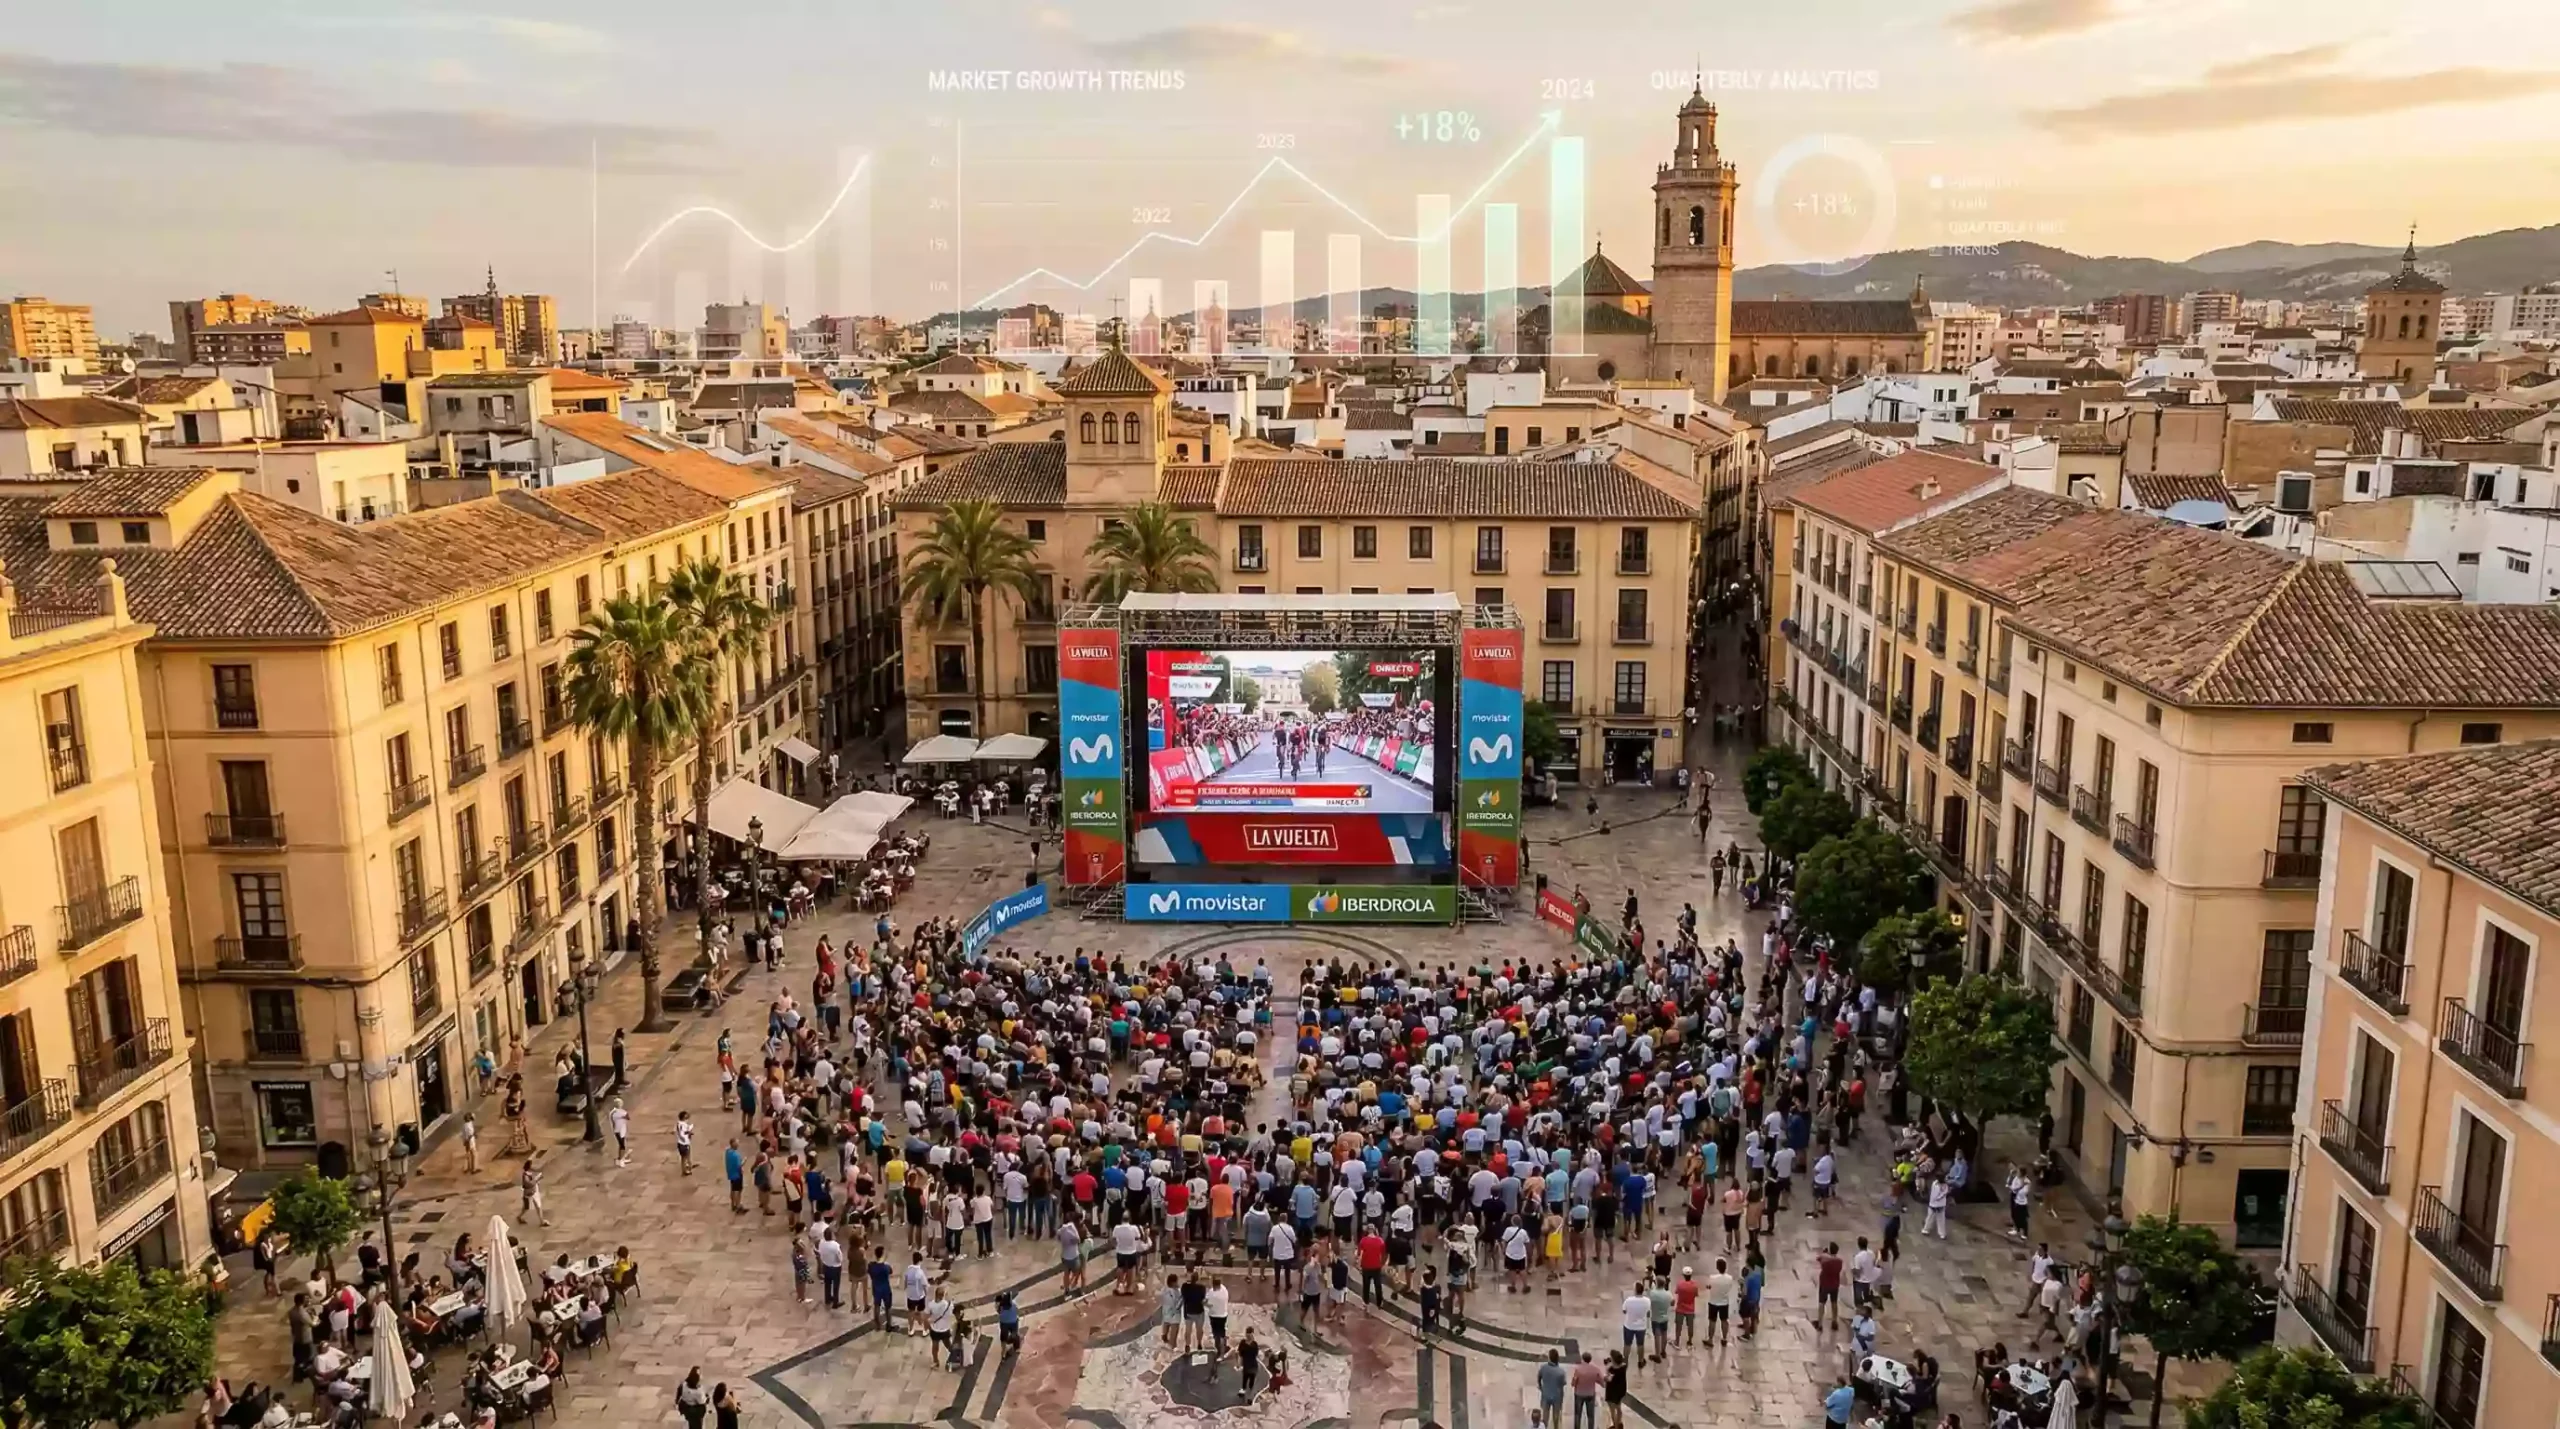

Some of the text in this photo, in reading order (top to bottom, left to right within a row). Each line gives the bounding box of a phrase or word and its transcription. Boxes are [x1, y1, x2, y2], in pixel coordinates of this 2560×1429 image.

[1071, 714, 1110, 722] movistar
[1471, 714, 1511, 722] movistar
[1253, 829, 1329, 846] LA VUELTA
[1010, 895, 1044, 916] movistar
[1186, 894, 1267, 911] movistar
[1342, 898, 1435, 912] IBERDROLA
